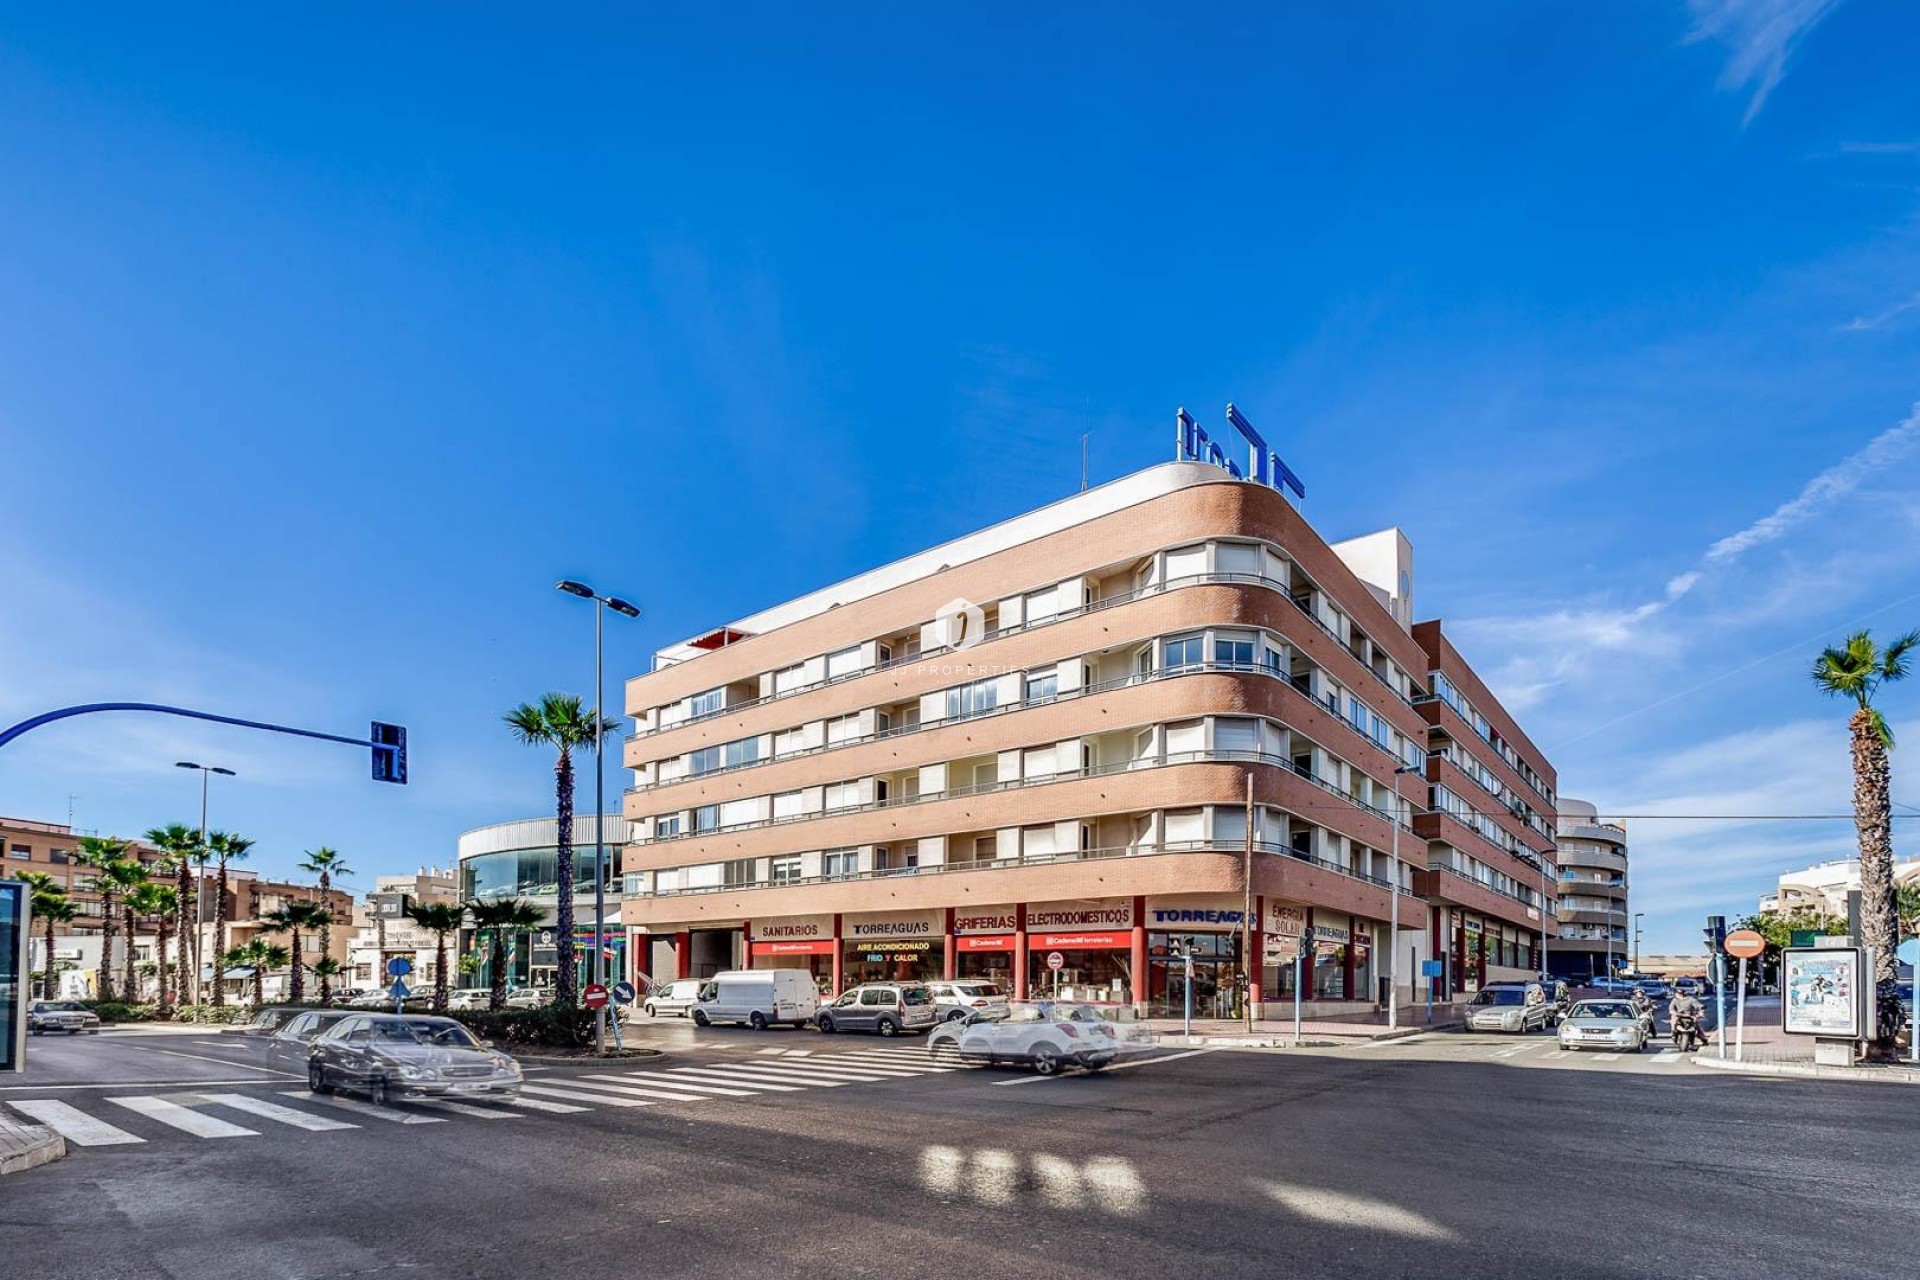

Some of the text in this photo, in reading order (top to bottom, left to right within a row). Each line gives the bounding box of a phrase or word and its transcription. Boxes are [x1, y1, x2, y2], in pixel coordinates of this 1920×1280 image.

[954, 915, 1017, 930] GRIFERIAS
[1027, 909, 1130, 926] ELECTRODOMESTICOS
[762, 924, 819, 937] SANITARIOS
[852, 921, 930, 935] TORREAGUAS
[857, 942, 930, 952] AIRE ACONDICIONADO
[867, 954, 918, 962] FRIO Y CALOR
